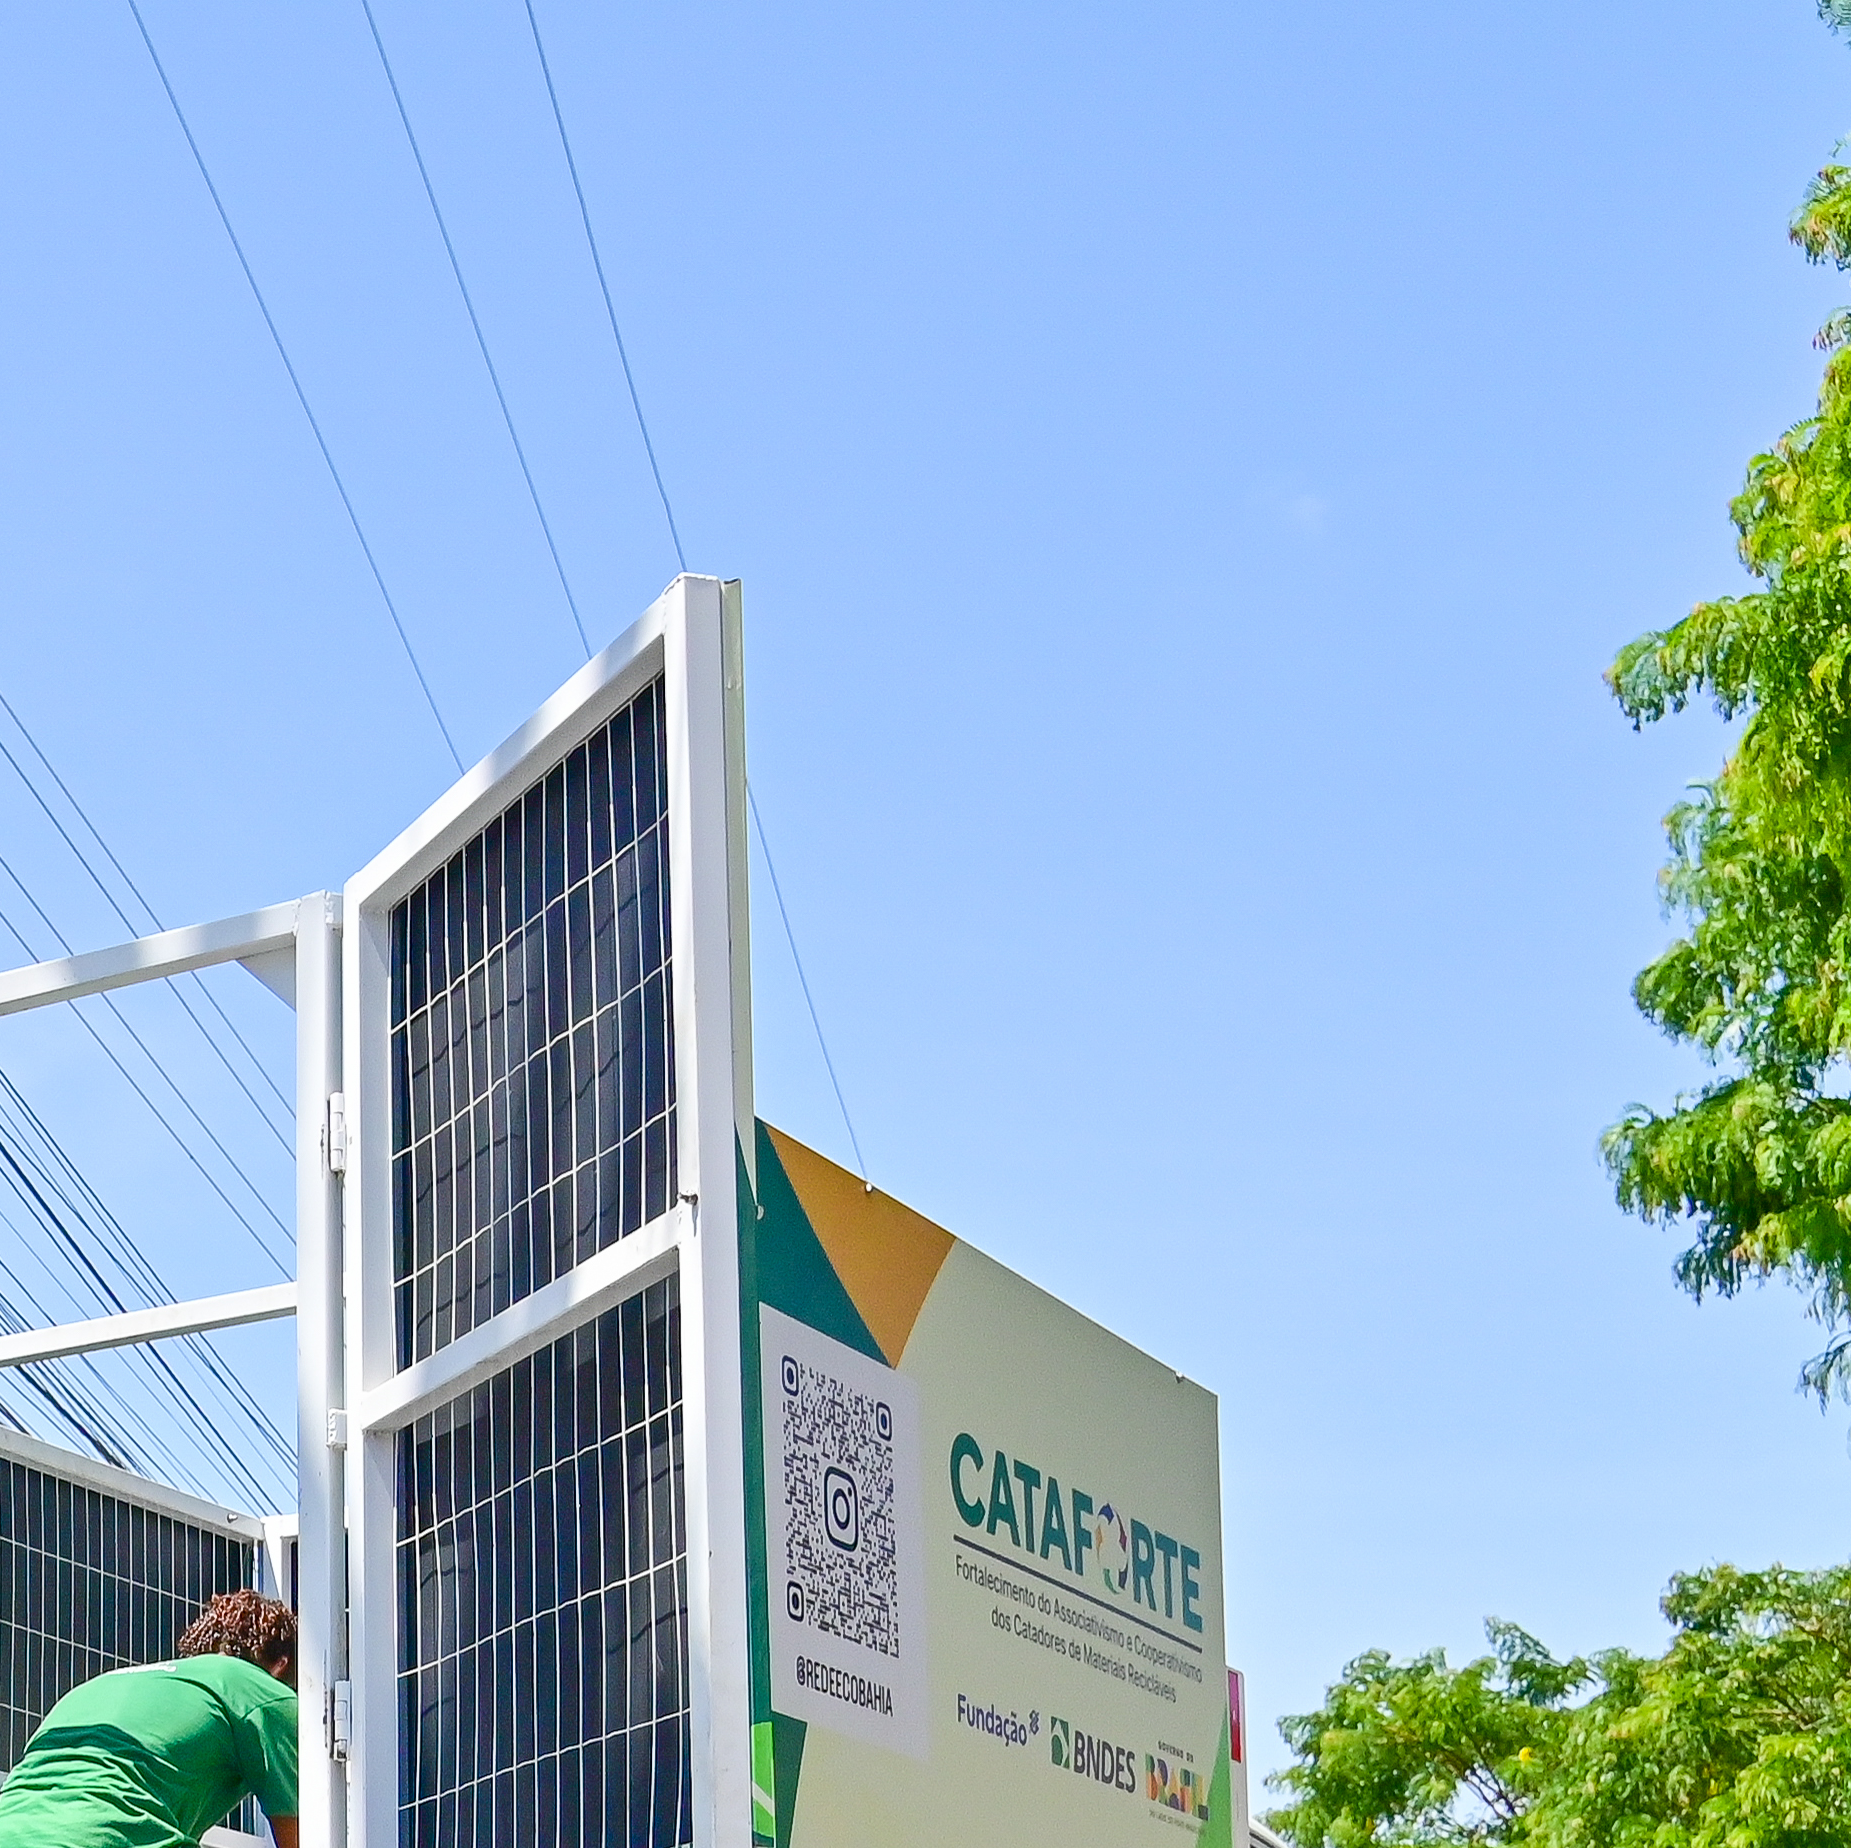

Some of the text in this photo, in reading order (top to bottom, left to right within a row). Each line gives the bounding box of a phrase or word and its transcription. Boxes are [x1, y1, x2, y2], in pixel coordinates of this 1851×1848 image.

[950, 1432, 1204, 1634] CATAFORTE
[956, 1554, 1036, 1609] Fortalecimento
[1038, 1592, 1052, 1617] do
[1054, 1597, 1125, 1651] Associativismo
[1135, 1634, 1203, 1683] Cooperativismo
[992, 1607, 1012, 1633] dos
[1014, 1614, 1066, 1656] Catadores
[1068, 1638, 1082, 1663] de
[1084, 1643, 1127, 1682] Materiais
[796, 1655, 894, 1717] @REDEECOBAHIA
[957, 1693, 1028, 1747] Fundação
[1074, 1731, 1136, 1794] BNDES
[1145, 1754, 1209, 1821] BRASIL
